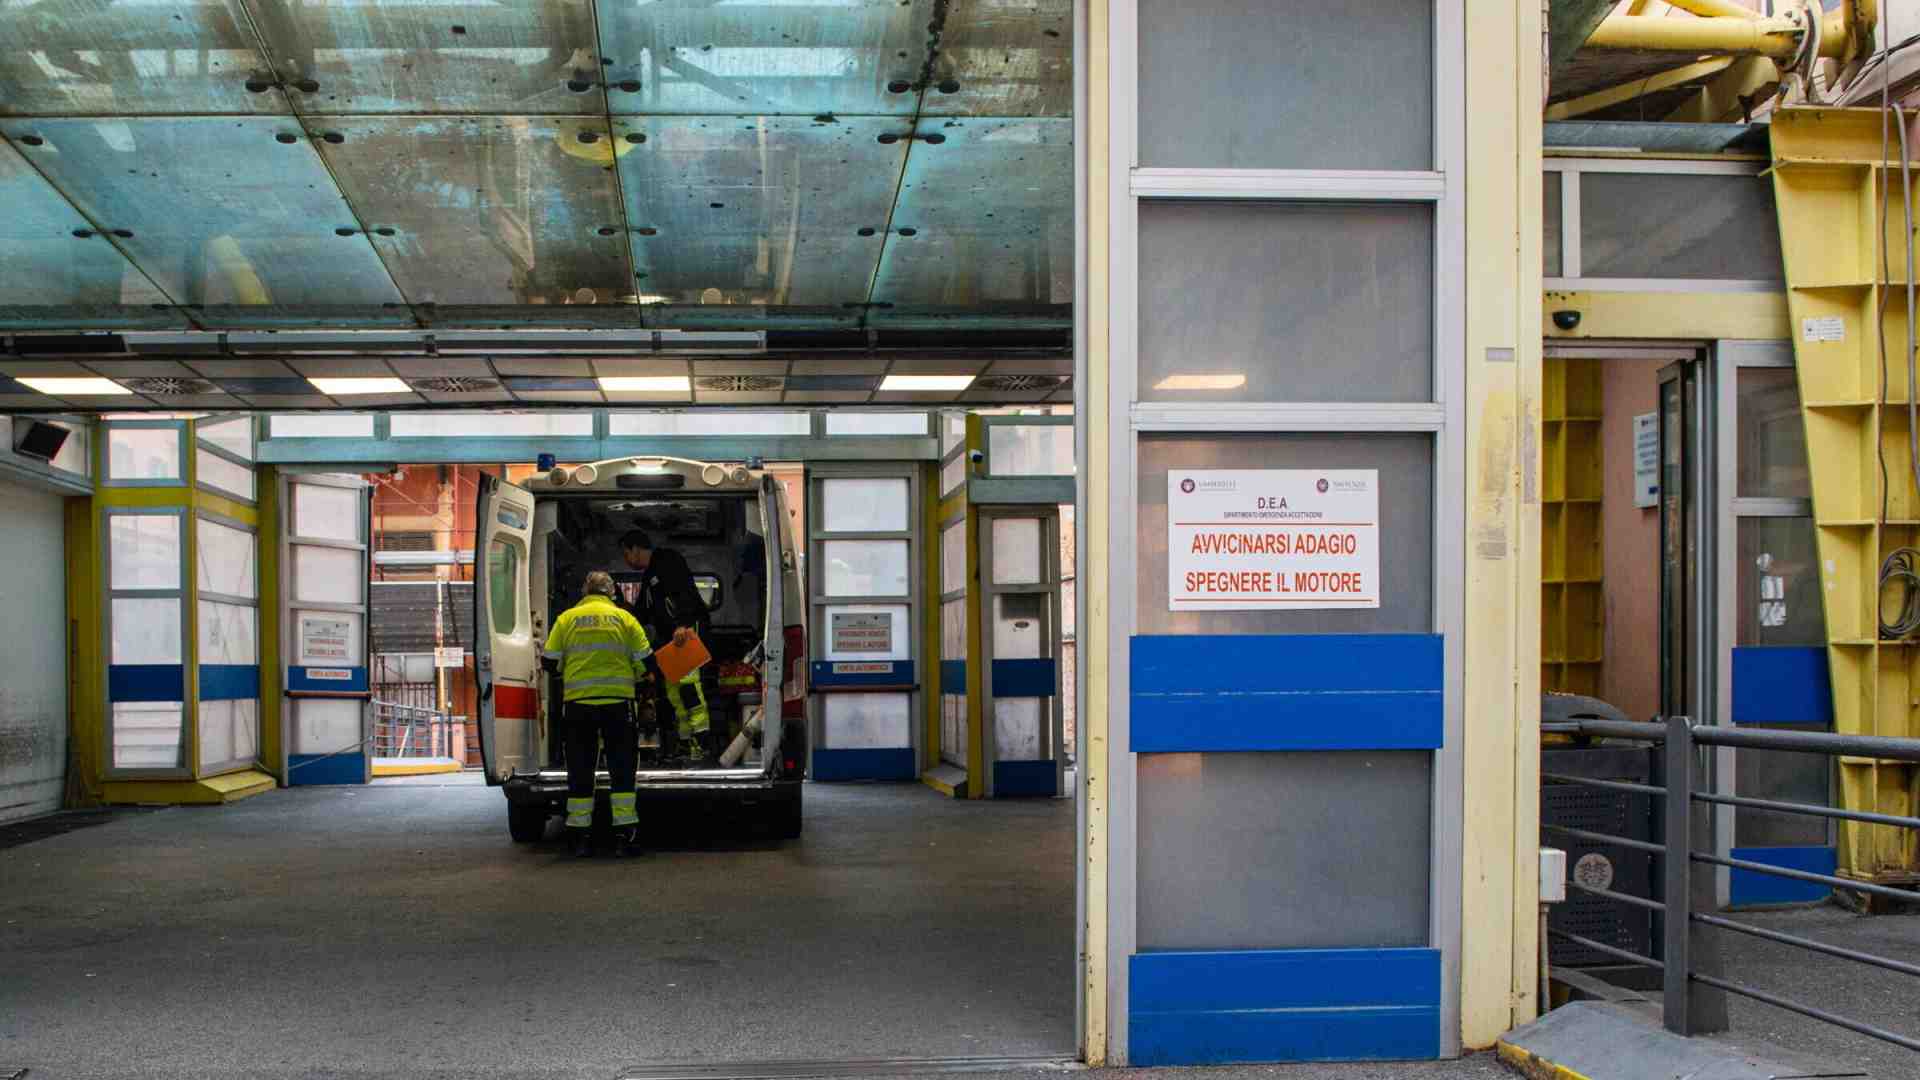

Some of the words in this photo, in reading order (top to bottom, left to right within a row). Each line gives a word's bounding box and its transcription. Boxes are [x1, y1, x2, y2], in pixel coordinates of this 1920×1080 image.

[1191, 533, 1290, 555] AVVICINARSI
[1294, 533, 1357, 555] ADAGIO
[1185, 571, 1272, 593] SPEGNERE
[1276, 572, 1291, 593] IL
[1294, 572, 1362, 593] MOTORE
